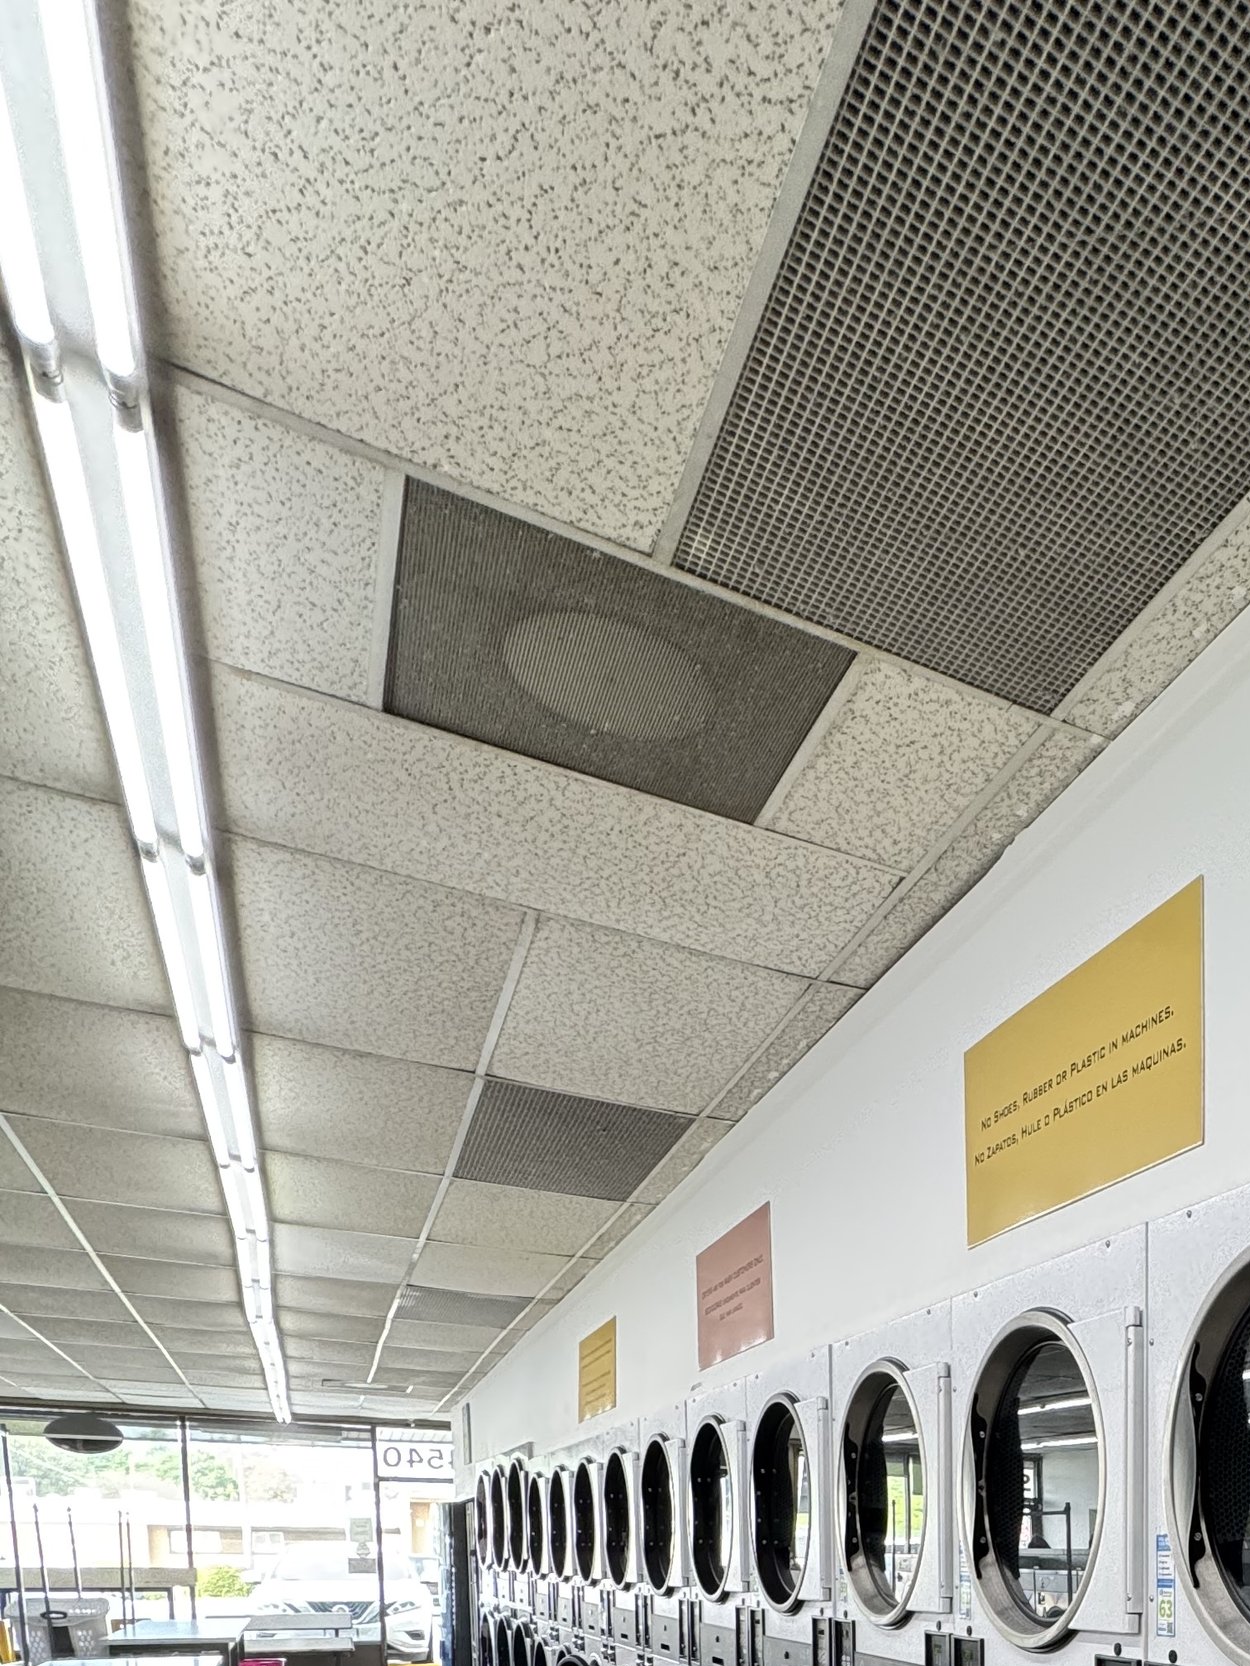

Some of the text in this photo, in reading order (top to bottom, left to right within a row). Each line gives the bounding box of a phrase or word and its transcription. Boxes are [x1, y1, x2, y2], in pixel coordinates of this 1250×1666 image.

[975, 1038, 1186, 1166] NO ZAPATOS, HULE O PLÁSTICO EN LAS MAQUINAS.
[981, 1005, 1174, 1131] NO SHOES, RUBBER OR PLASTIC IN MACHINES.
[1159, 1599, 1172, 1618] 63
